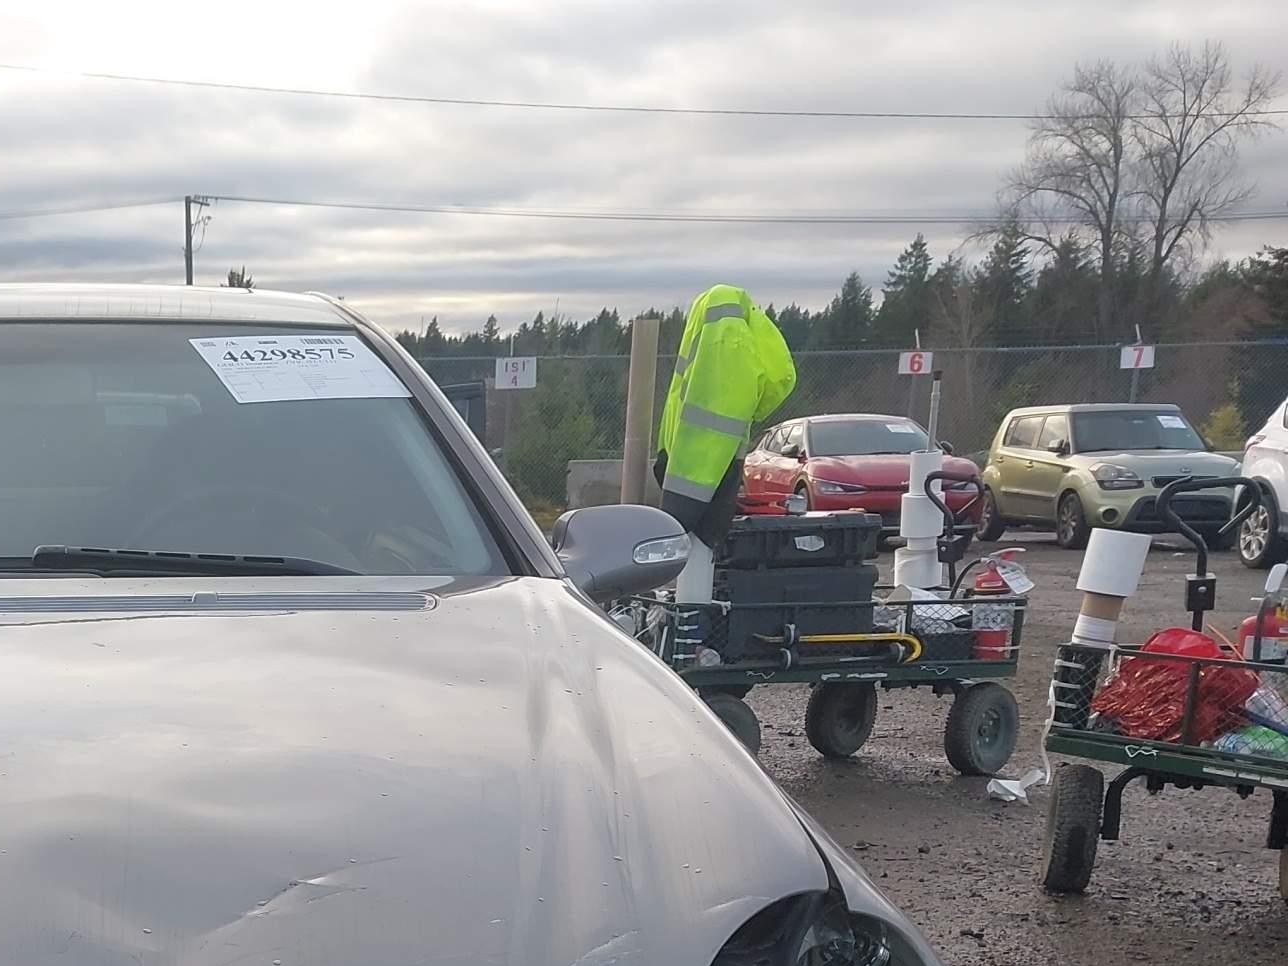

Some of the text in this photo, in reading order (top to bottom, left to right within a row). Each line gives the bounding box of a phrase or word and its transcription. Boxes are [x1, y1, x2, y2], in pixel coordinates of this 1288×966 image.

[222, 347, 355, 363] 44298575
[909, 353, 923, 372] 6
[1133, 347, 1145, 368] 7
